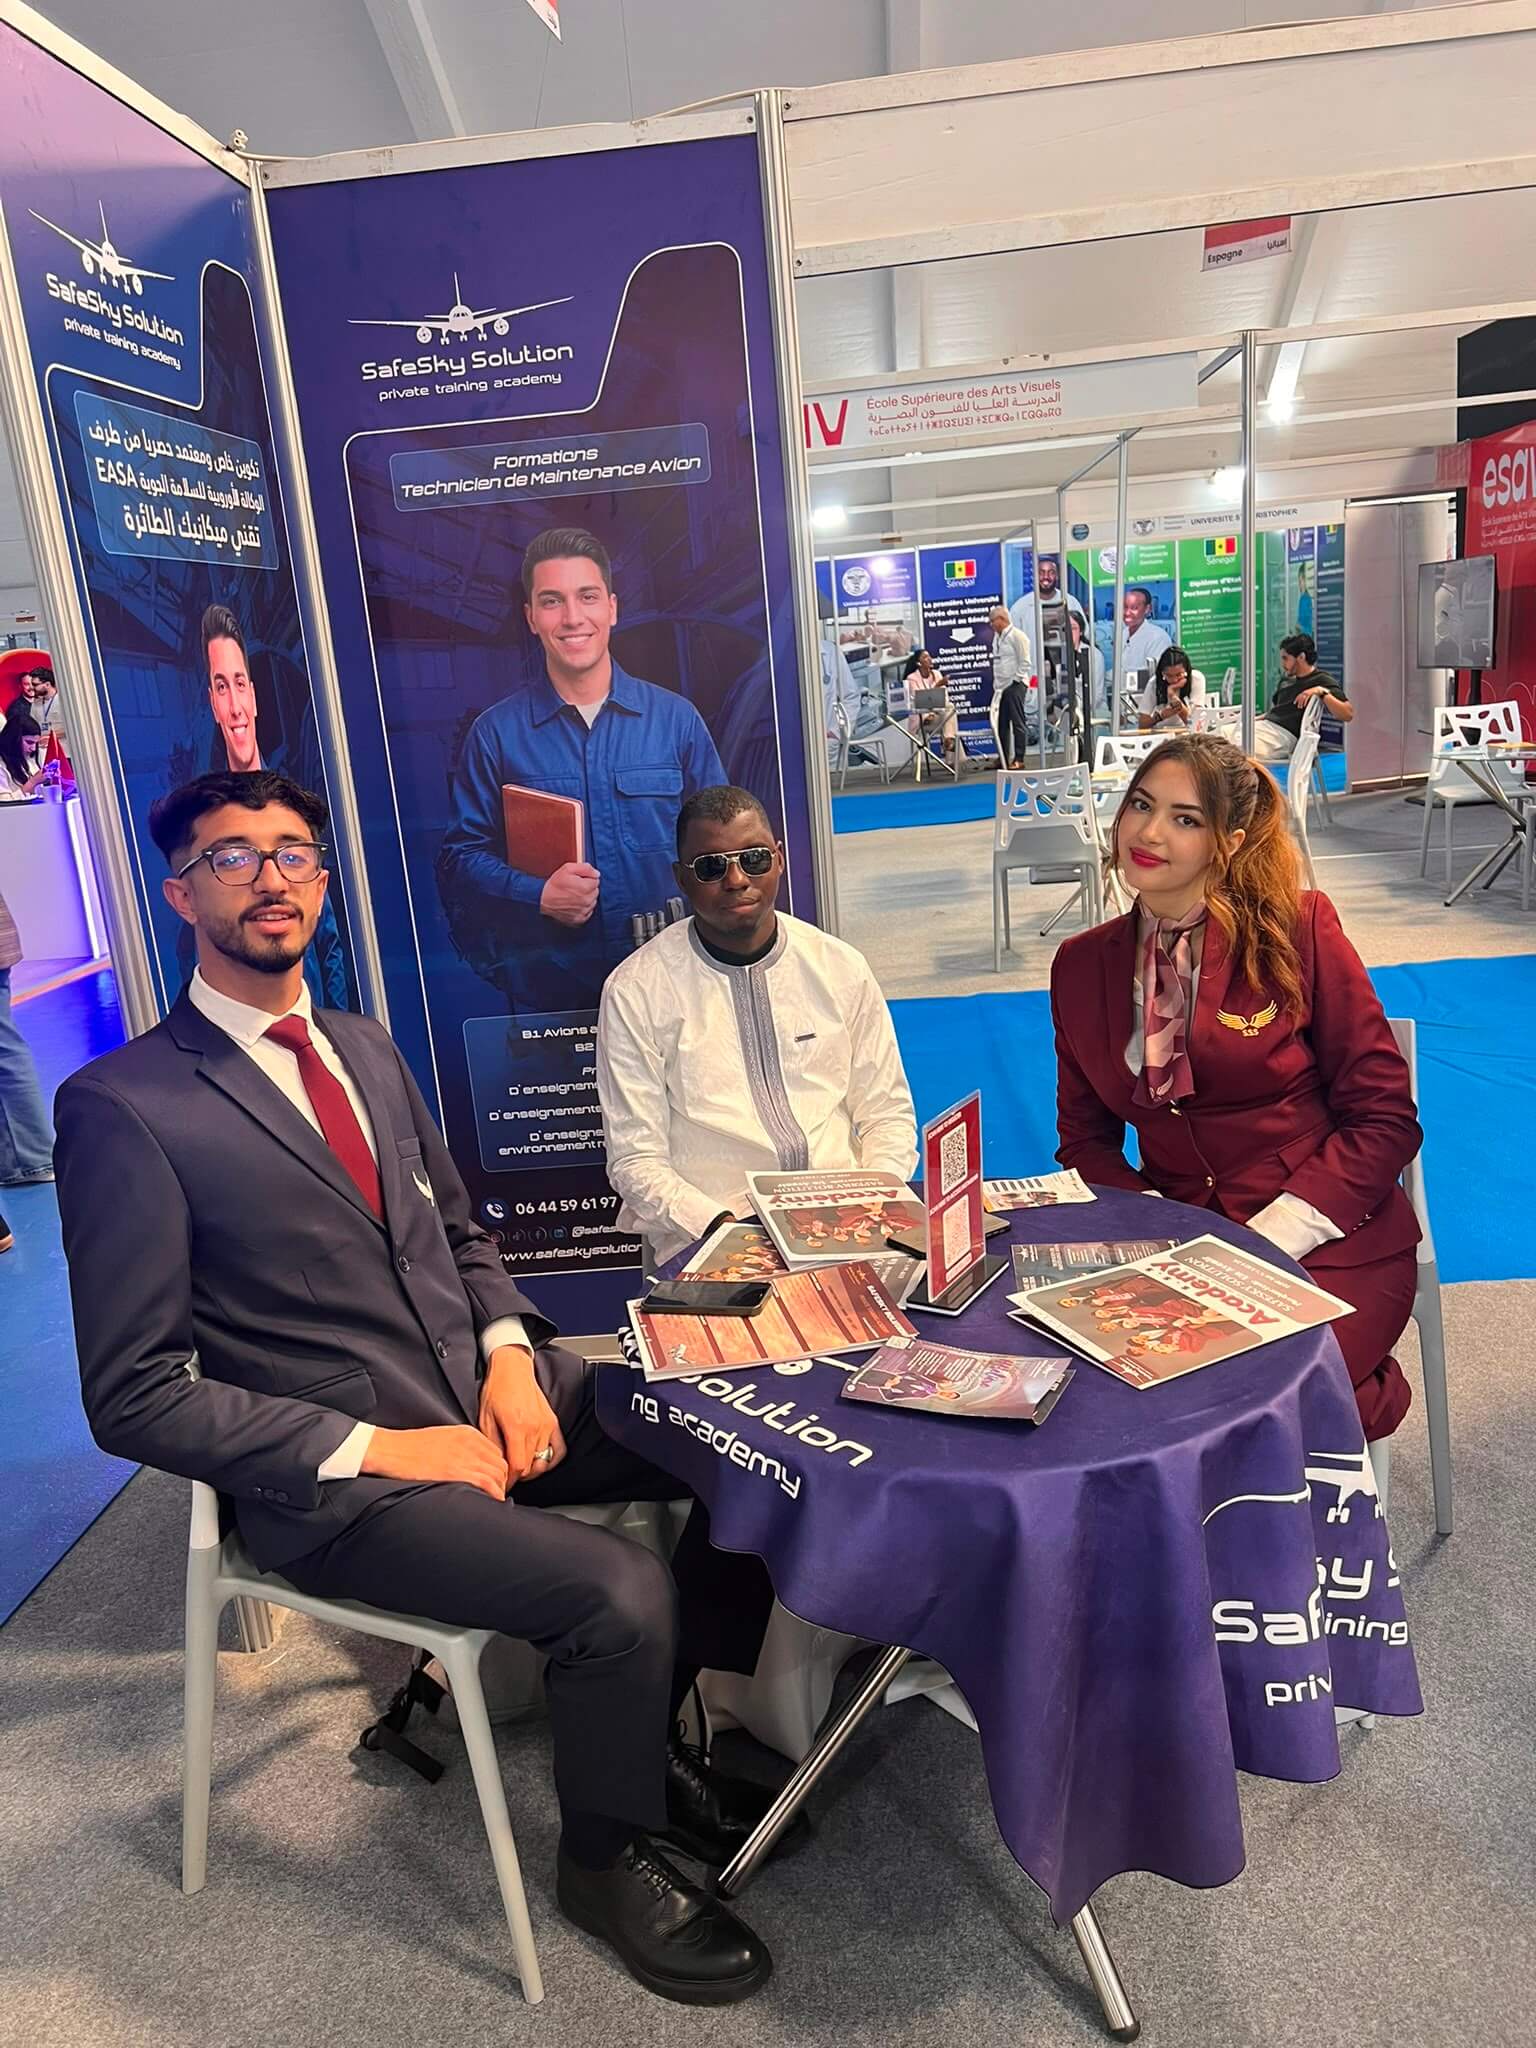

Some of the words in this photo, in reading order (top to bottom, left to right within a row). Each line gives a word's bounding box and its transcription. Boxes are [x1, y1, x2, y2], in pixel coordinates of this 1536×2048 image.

[1207, 249, 1243, 264] Espagne
[46, 272, 122, 329] SafeSky
[123, 305, 184, 346] Solution
[64, 316, 101, 341] private
[104, 329, 139, 356] training
[141, 343, 182, 371] academy
[361, 350, 466, 381] SafeSky
[471, 344, 574, 370] Solution
[379, 385, 430, 402] private
[435, 379, 488, 396] training
[493, 371, 562, 389] academy
[867, 395, 898, 410] École
[900, 391, 964, 407] Supérieure
[967, 388, 988, 399] des
[991, 384, 1017, 396] Arts
[1019, 378, 1062, 392] Visuels
[88, 419, 121, 448] طرف
[123, 430, 141, 453] من
[95, 456, 139, 488] EASA
[493, 447, 599, 471] Formations
[401, 474, 502, 499] Technicien
[503, 473, 529, 489] de
[530, 461, 646, 487] Maintenance
[648, 456, 702, 474] Avion
[123, 502, 176, 539] الطائرة
[1190, 513, 1233, 525] UNIVERSITE
[231, 524, 261, 557] تقني
[967, 616, 991, 624] Sénég
[932, 654, 975, 663] niversitaires
[522, 1030, 542, 1040] B1
[543, 1025, 588, 1039] Avions
[575, 1043, 594, 1052] B2
[515, 1202, 535, 1216] 06
[538, 1200, 557, 1213] 44
[560, 1199, 578, 1212] 59
[581, 1198, 597, 1210] 61
[600, 1196, 617, 1208] 97
[768, 1189, 899, 1204] Academy
[1184, 1256, 1245, 1288] SOLUTION
[1150, 1261, 1280, 1325] Academy
[677, 1374, 873, 1467] olution
[668, 1405, 801, 1499] academy
